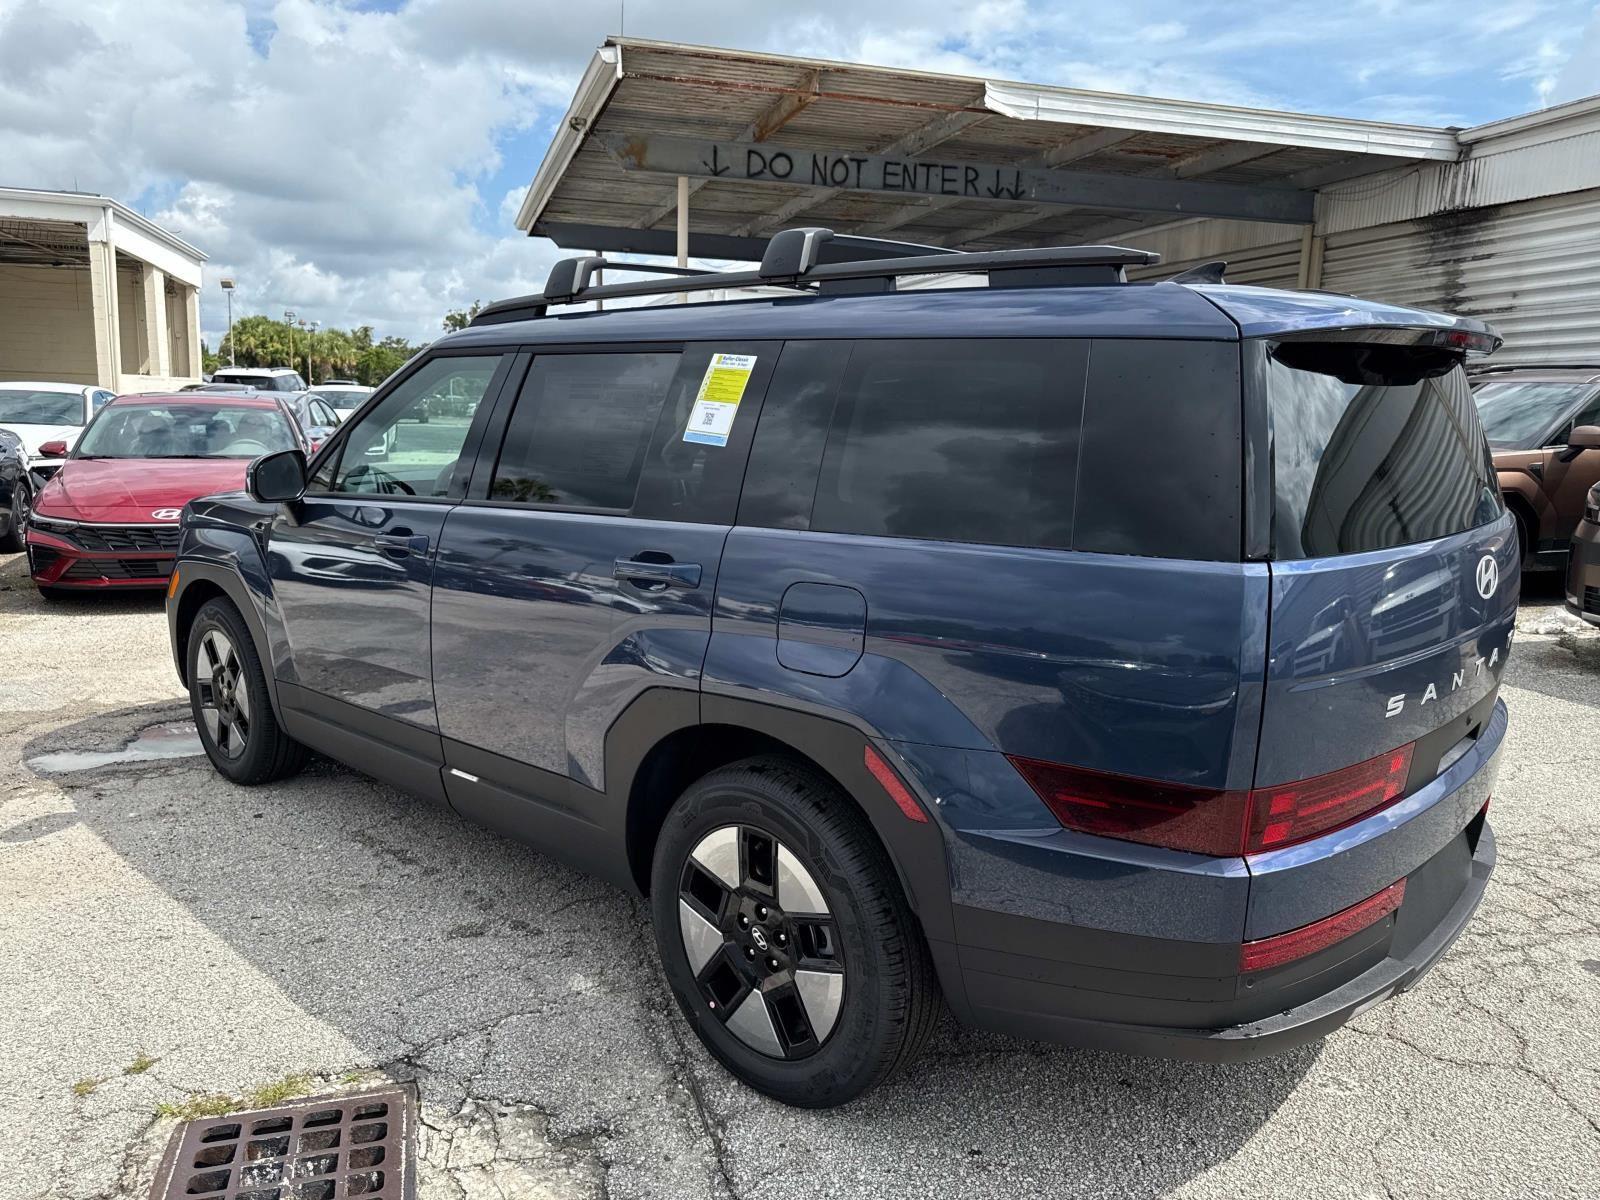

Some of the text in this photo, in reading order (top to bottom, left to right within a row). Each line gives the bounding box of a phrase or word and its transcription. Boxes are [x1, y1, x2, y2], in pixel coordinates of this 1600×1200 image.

[746, 149, 980, 196] DO NOT ENTER
[1386, 647, 1499, 718] SANTA
